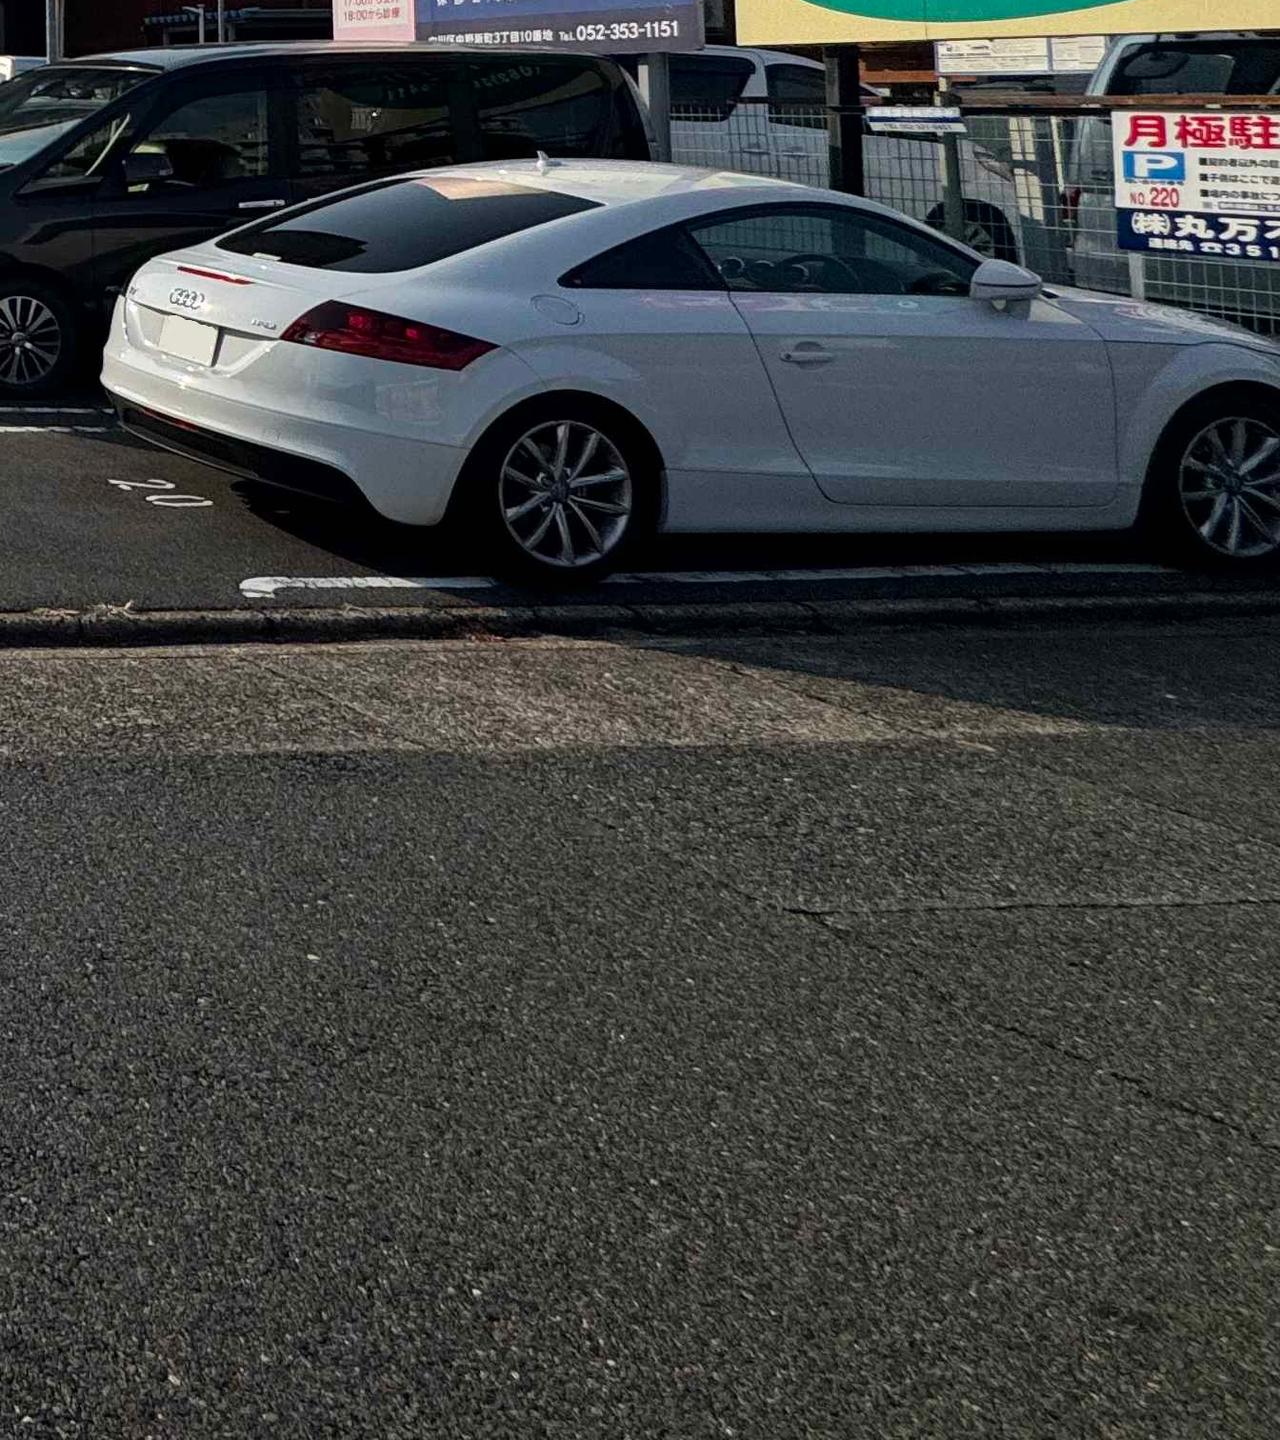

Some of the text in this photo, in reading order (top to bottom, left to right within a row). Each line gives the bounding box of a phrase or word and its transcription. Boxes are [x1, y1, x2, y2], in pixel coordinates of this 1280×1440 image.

[576, 20, 679, 41] 052-353-1151
[1124, 114, 1280, 149] 月極駐
[1150, 187, 1180, 207] 220
